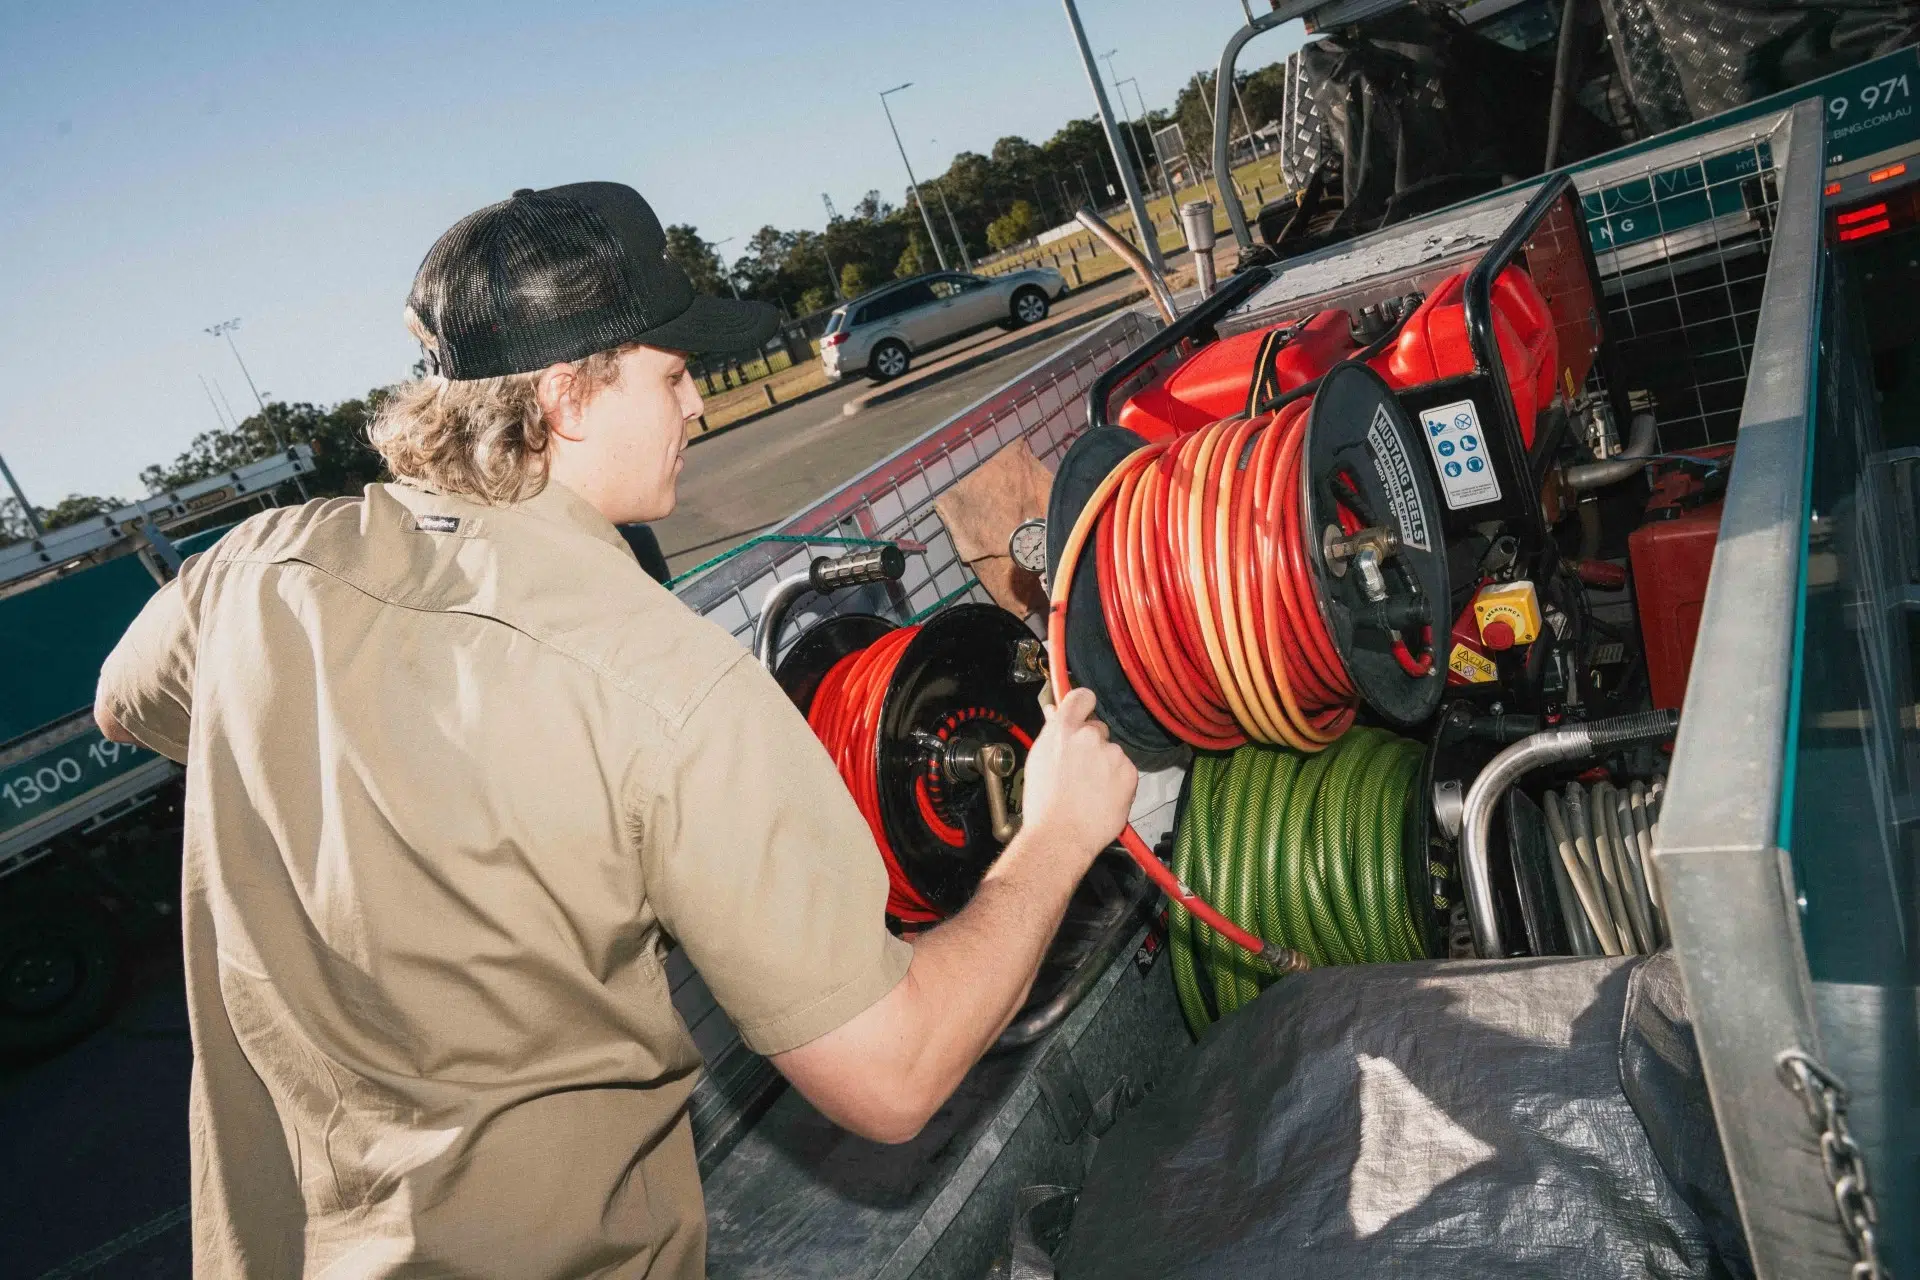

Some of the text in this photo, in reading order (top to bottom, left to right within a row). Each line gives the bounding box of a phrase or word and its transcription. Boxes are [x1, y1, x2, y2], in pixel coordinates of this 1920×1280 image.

[1860, 74, 1909, 110] 971
[1376, 416, 1424, 541] MUSTANG REELS
[1382, 453, 1401, 498] PREMIUM
[1485, 606, 1521, 621] EMERGENCY
[2, 757, 82, 809] 1300
